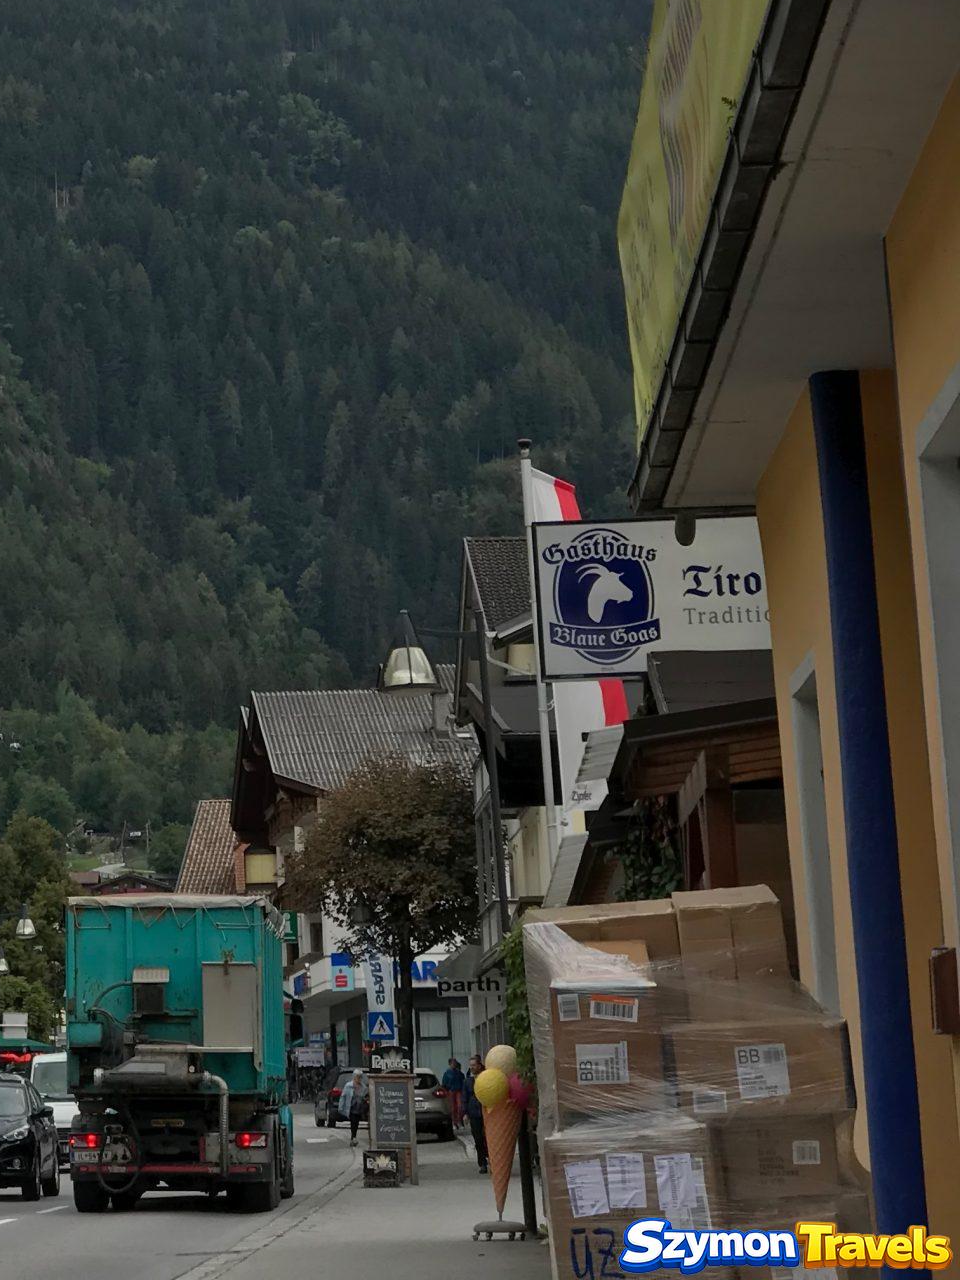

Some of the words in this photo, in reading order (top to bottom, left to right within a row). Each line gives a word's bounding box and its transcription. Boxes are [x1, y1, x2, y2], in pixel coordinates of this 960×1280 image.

[542, 536, 658, 565] Gasthaus
[682, 564, 763, 598] Tiro
[553, 626, 606, 646] Blaue
[611, 626, 658, 646] Goas
[438, 976, 500, 996] parth
[737, 1048, 761, 1065] BB
[580, 1060, 593, 1081] BB
